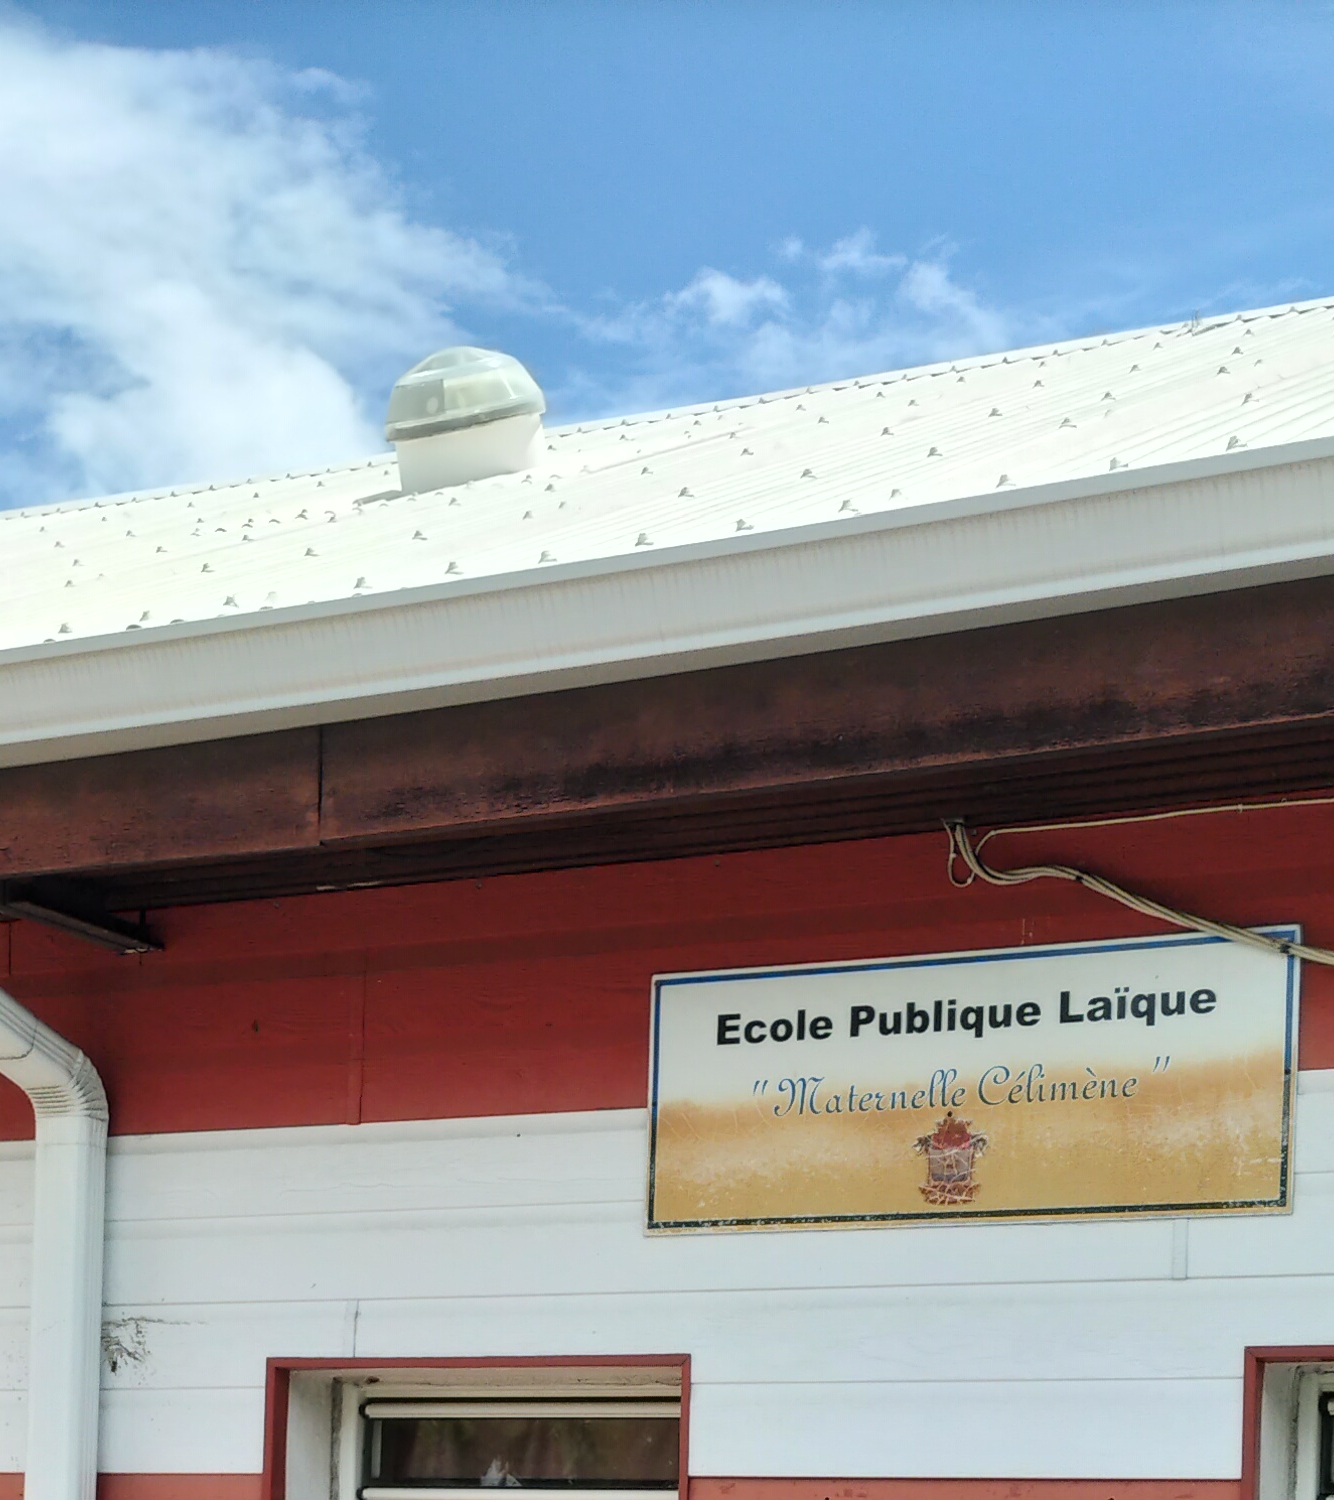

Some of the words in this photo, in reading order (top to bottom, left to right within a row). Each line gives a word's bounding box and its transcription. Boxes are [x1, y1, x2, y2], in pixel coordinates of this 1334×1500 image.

[717, 1009, 833, 1046] Ecole
[850, 999, 1041, 1038] Publique
[1059, 987, 1217, 1026] Laïque
